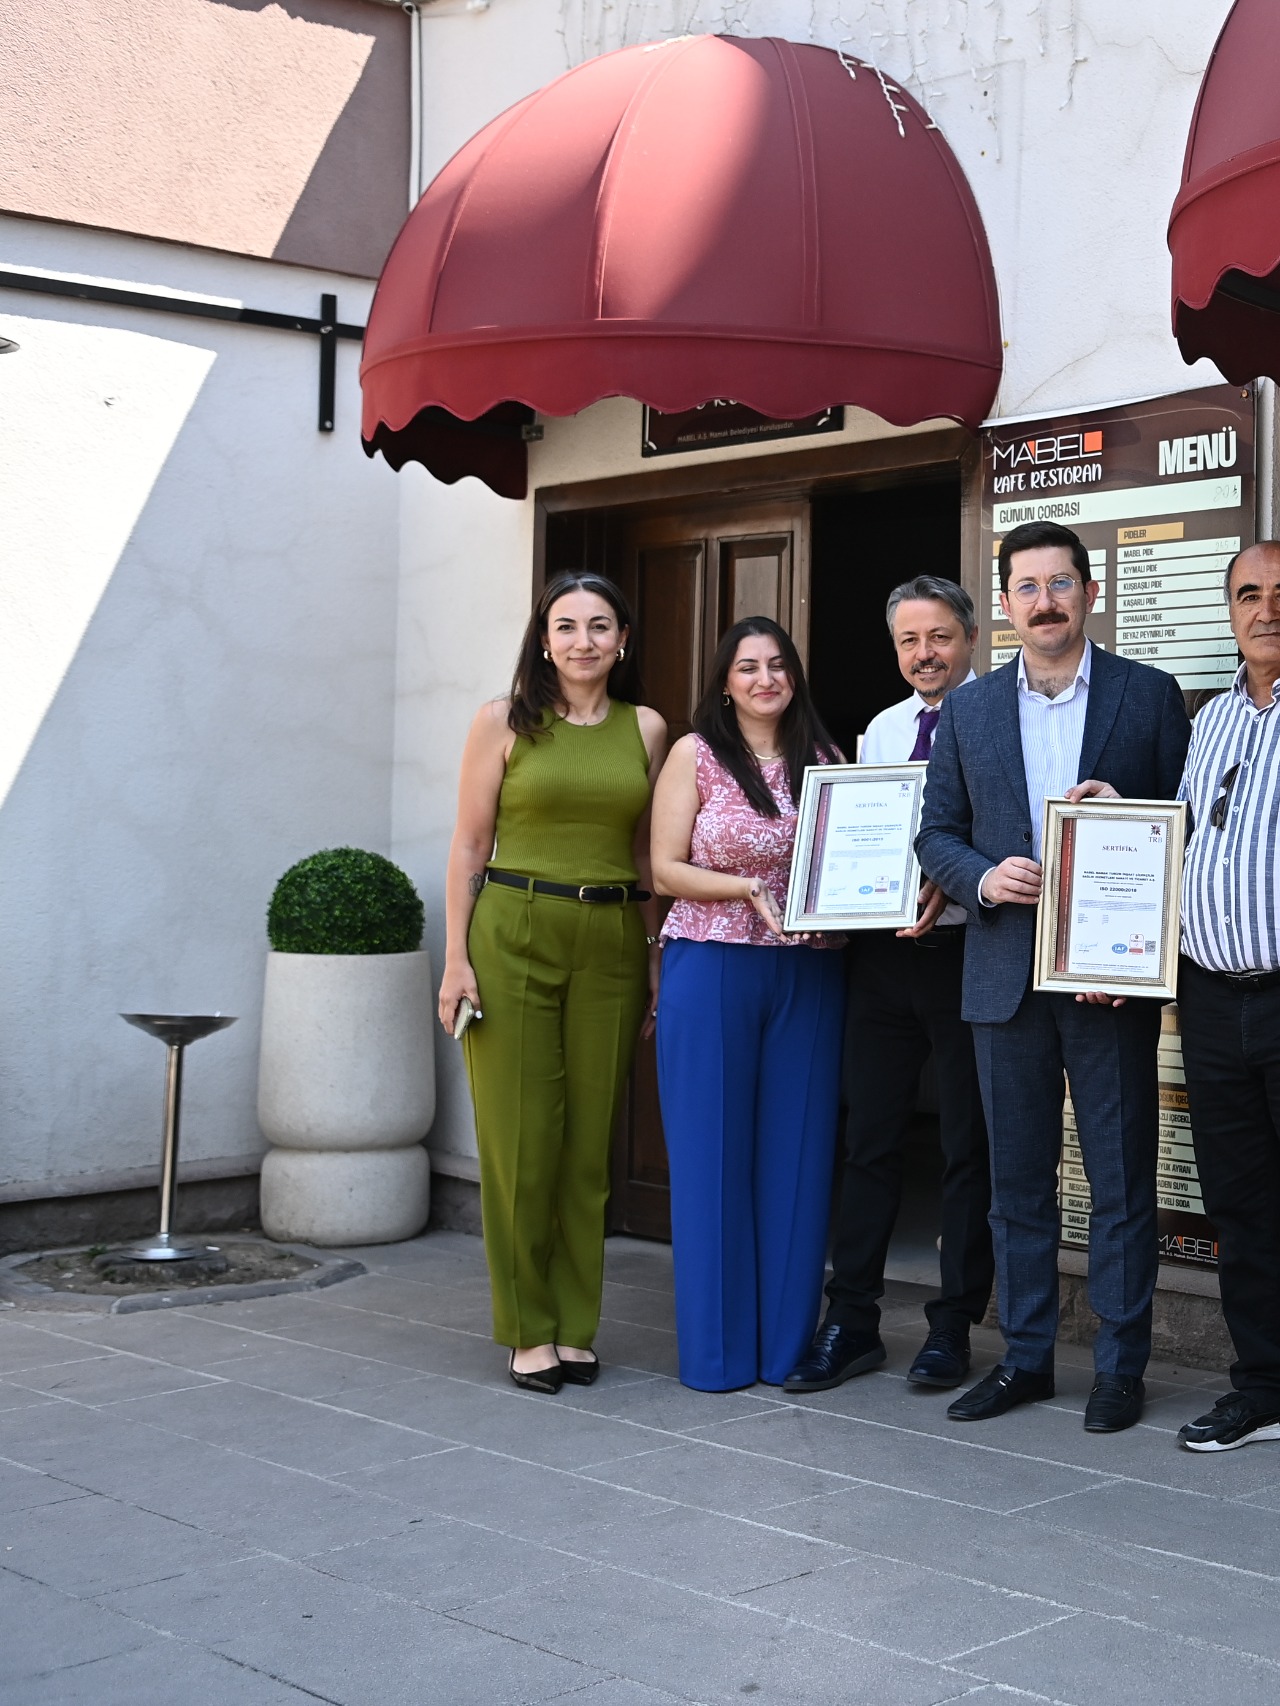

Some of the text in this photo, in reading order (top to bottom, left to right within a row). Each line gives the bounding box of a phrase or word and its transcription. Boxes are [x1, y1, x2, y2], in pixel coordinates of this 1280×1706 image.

[993, 433, 1102, 470] MABEL
[1158, 425, 1237, 476] MENÜ
[993, 463, 1102, 494] KAFE RESTORAN
[999, 501, 1081, 523] GÜNÜN ÇORBASI
[1123, 529, 1147, 540] PİDELER
[1123, 548, 1154, 558] MABEL PİDE
[1123, 564, 1158, 574] KIYMALI PİDE
[1151, 580, 1162, 589] PİDE
[1123, 597, 1157, 608] KAŞARLI PİDE
[1151, 613, 1162, 622] PİDE
[1123, 630, 1139, 640] BEYAZ
[1164, 628, 1176, 638] PİDE
[1123, 646, 1159, 656] SUCUKLU PİDE
[1102, 844, 1138, 853] SERTİFİKA
[1172, 1163, 1192, 1174] AYRAN
[1157, 1179, 1189, 1191] ADEN SUYU
[1157, 1195, 1191, 1208] EYVELİ SODA
[1067, 1215, 1087, 1225] SAHLEP
[1067, 1230, 1089, 1241] CAPPUC
